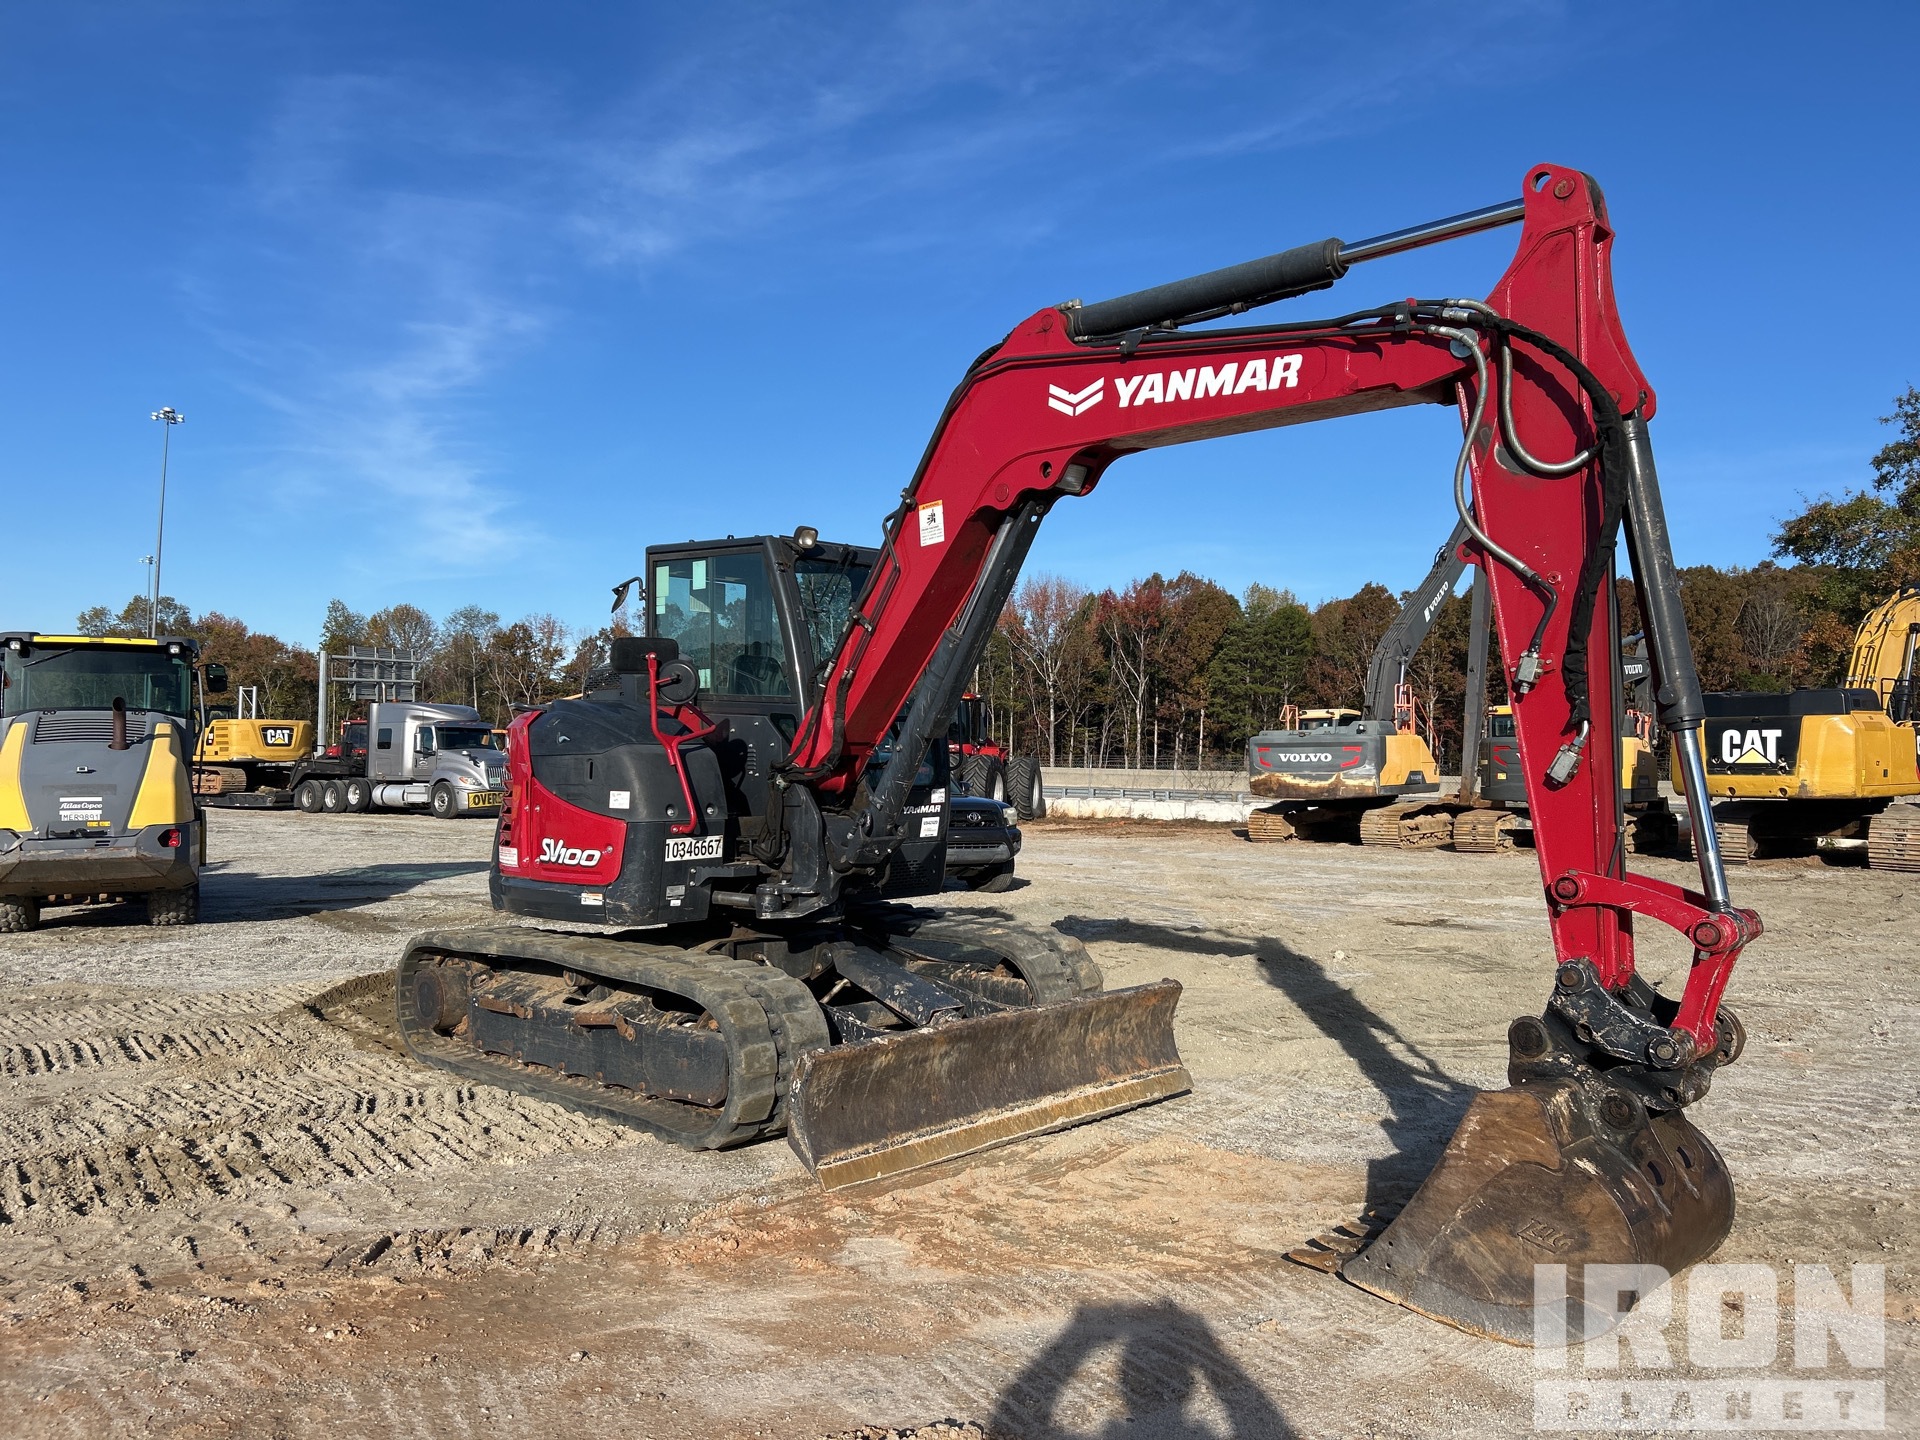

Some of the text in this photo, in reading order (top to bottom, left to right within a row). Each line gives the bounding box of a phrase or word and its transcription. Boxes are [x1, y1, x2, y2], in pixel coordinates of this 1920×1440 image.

[1114, 354, 1303, 408] YANMAR
[1429, 581, 1449, 612] VOLVO
[1624, 664, 1643, 675] VOLVO
[266, 729, 290, 744] CAT
[1722, 729, 1782, 764] CAT
[1278, 753, 1332, 762] VOLVO
[903, 805, 942, 815] YANMAR
[540, 838, 601, 866] SV100
[665, 839, 721, 859] 10346667
